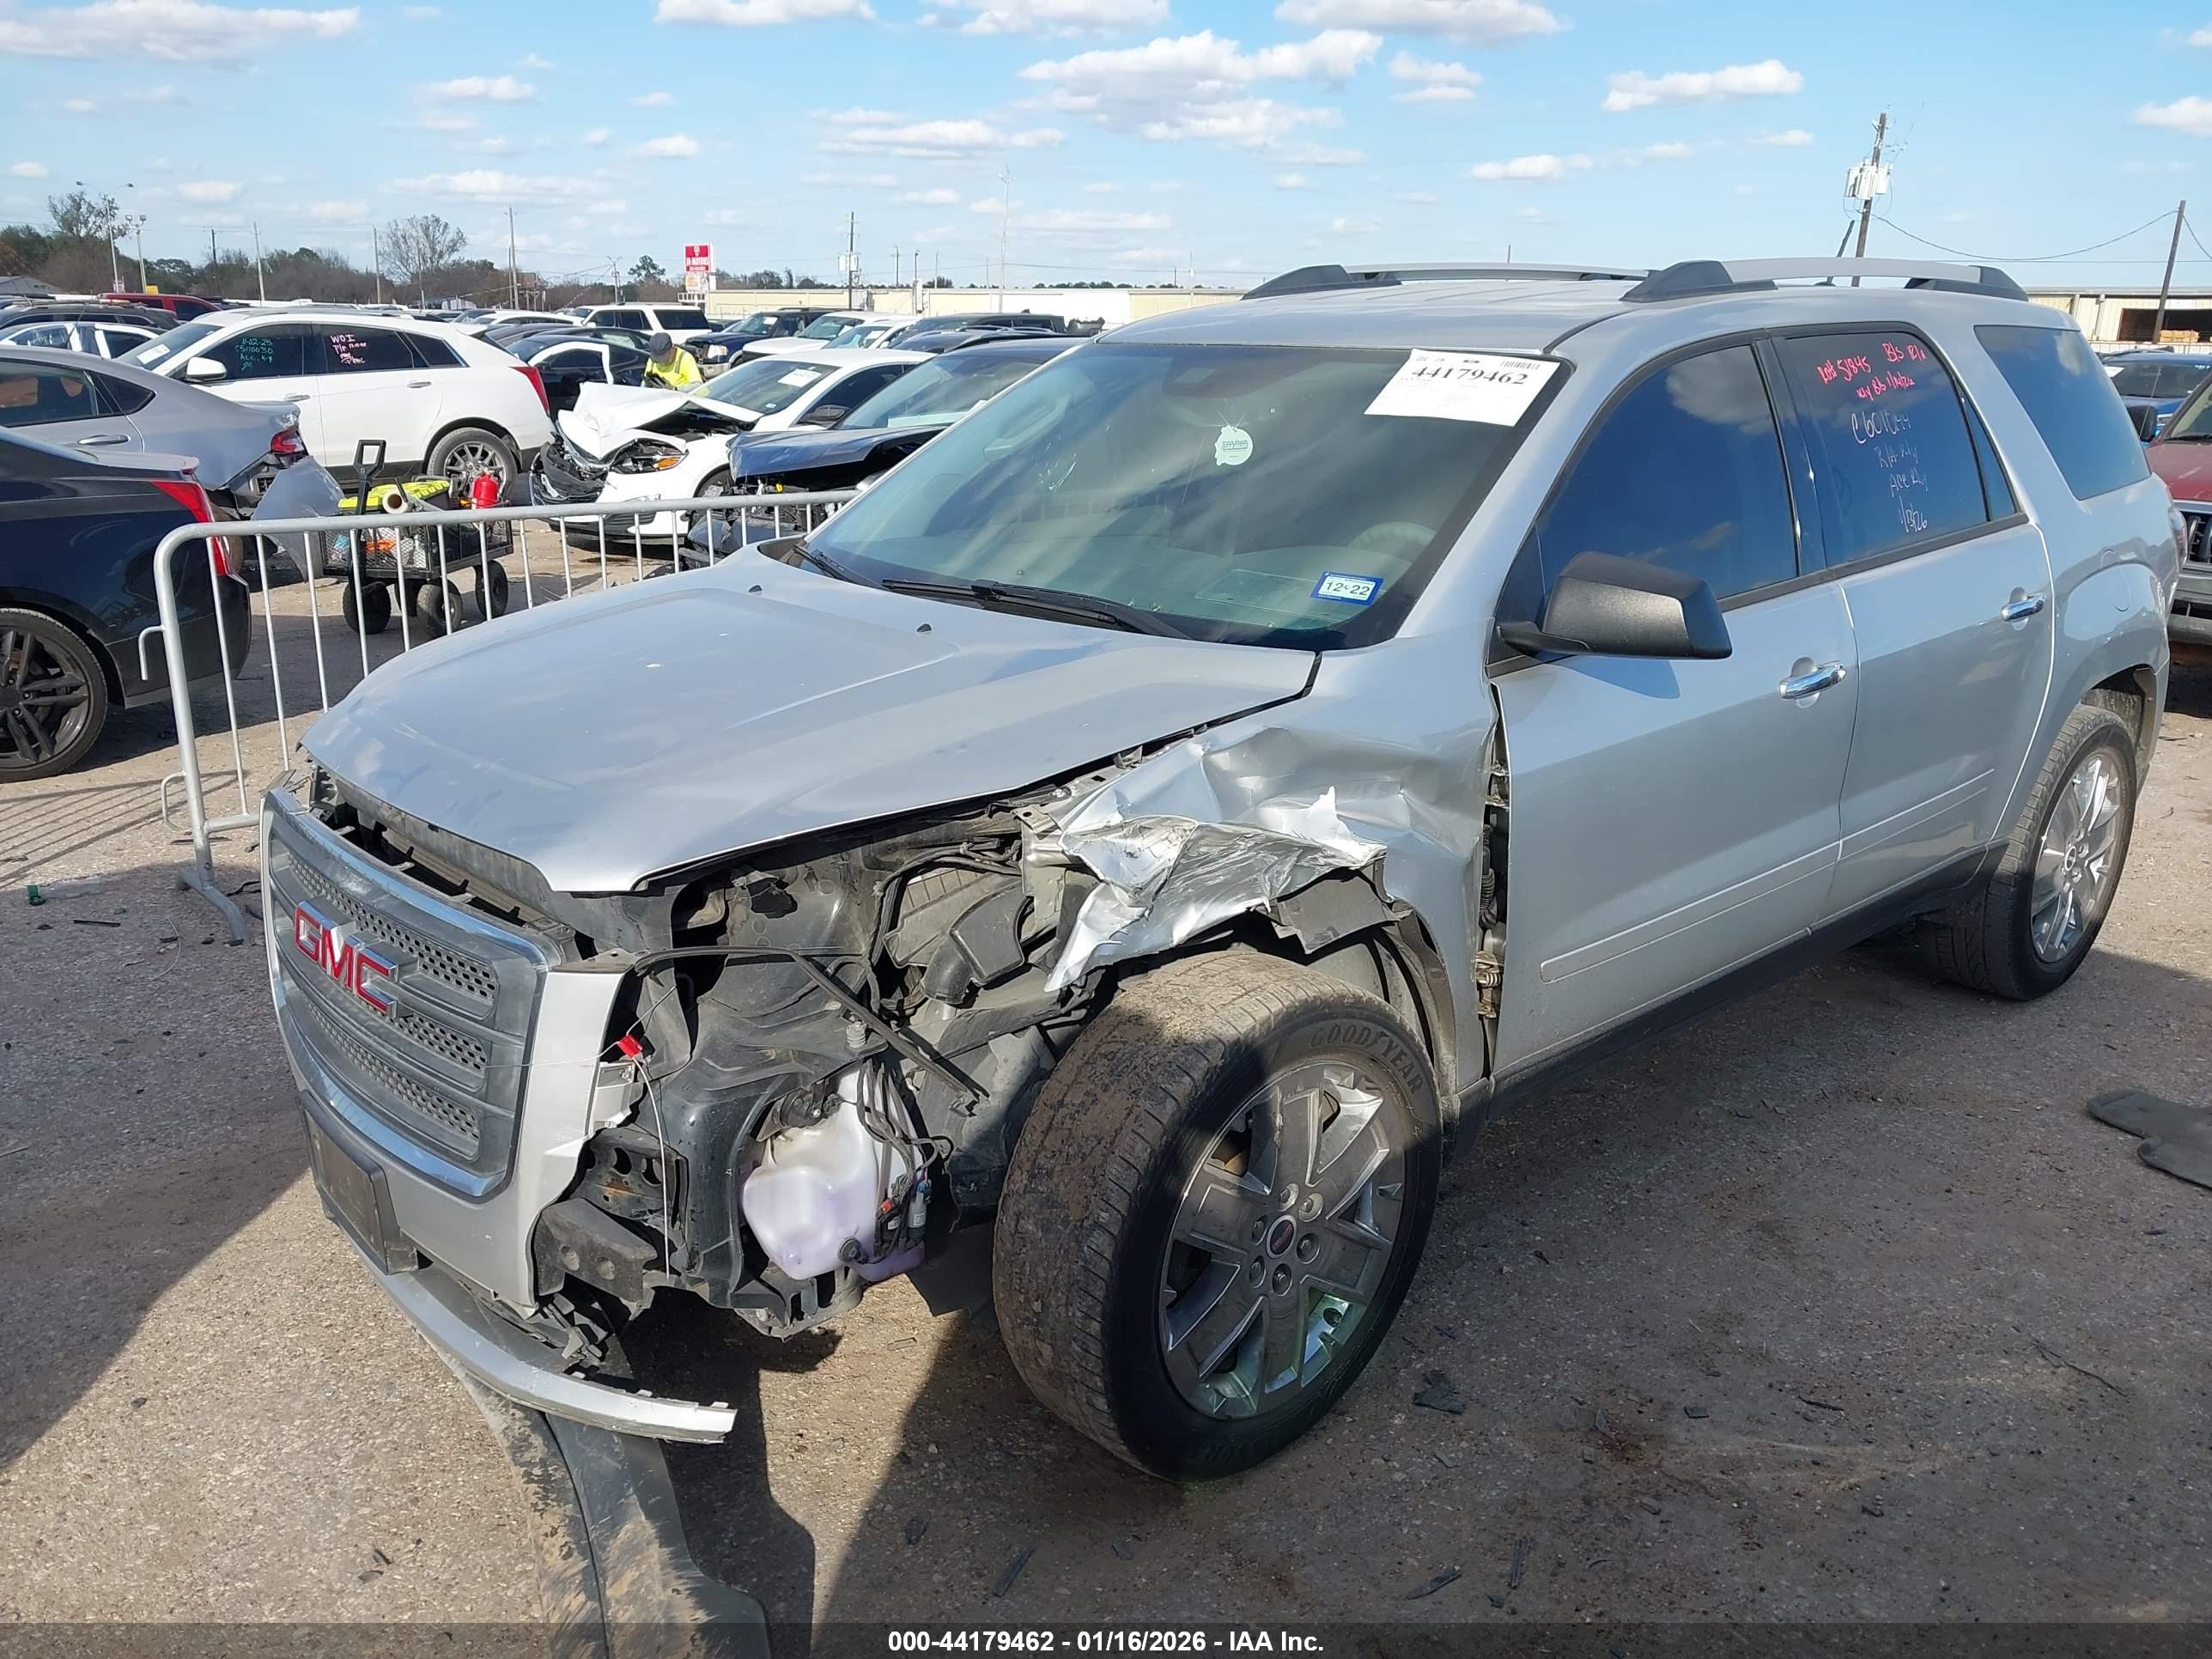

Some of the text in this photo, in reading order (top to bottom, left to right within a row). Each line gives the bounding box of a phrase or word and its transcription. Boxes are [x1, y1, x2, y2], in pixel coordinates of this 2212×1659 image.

[1413, 367, 1528, 385] 44179462
[1327, 581, 1370, 596] 12 22
[295, 901, 398, 1019] GMC
[1310, 1024, 1425, 1095] GOODYEAR
